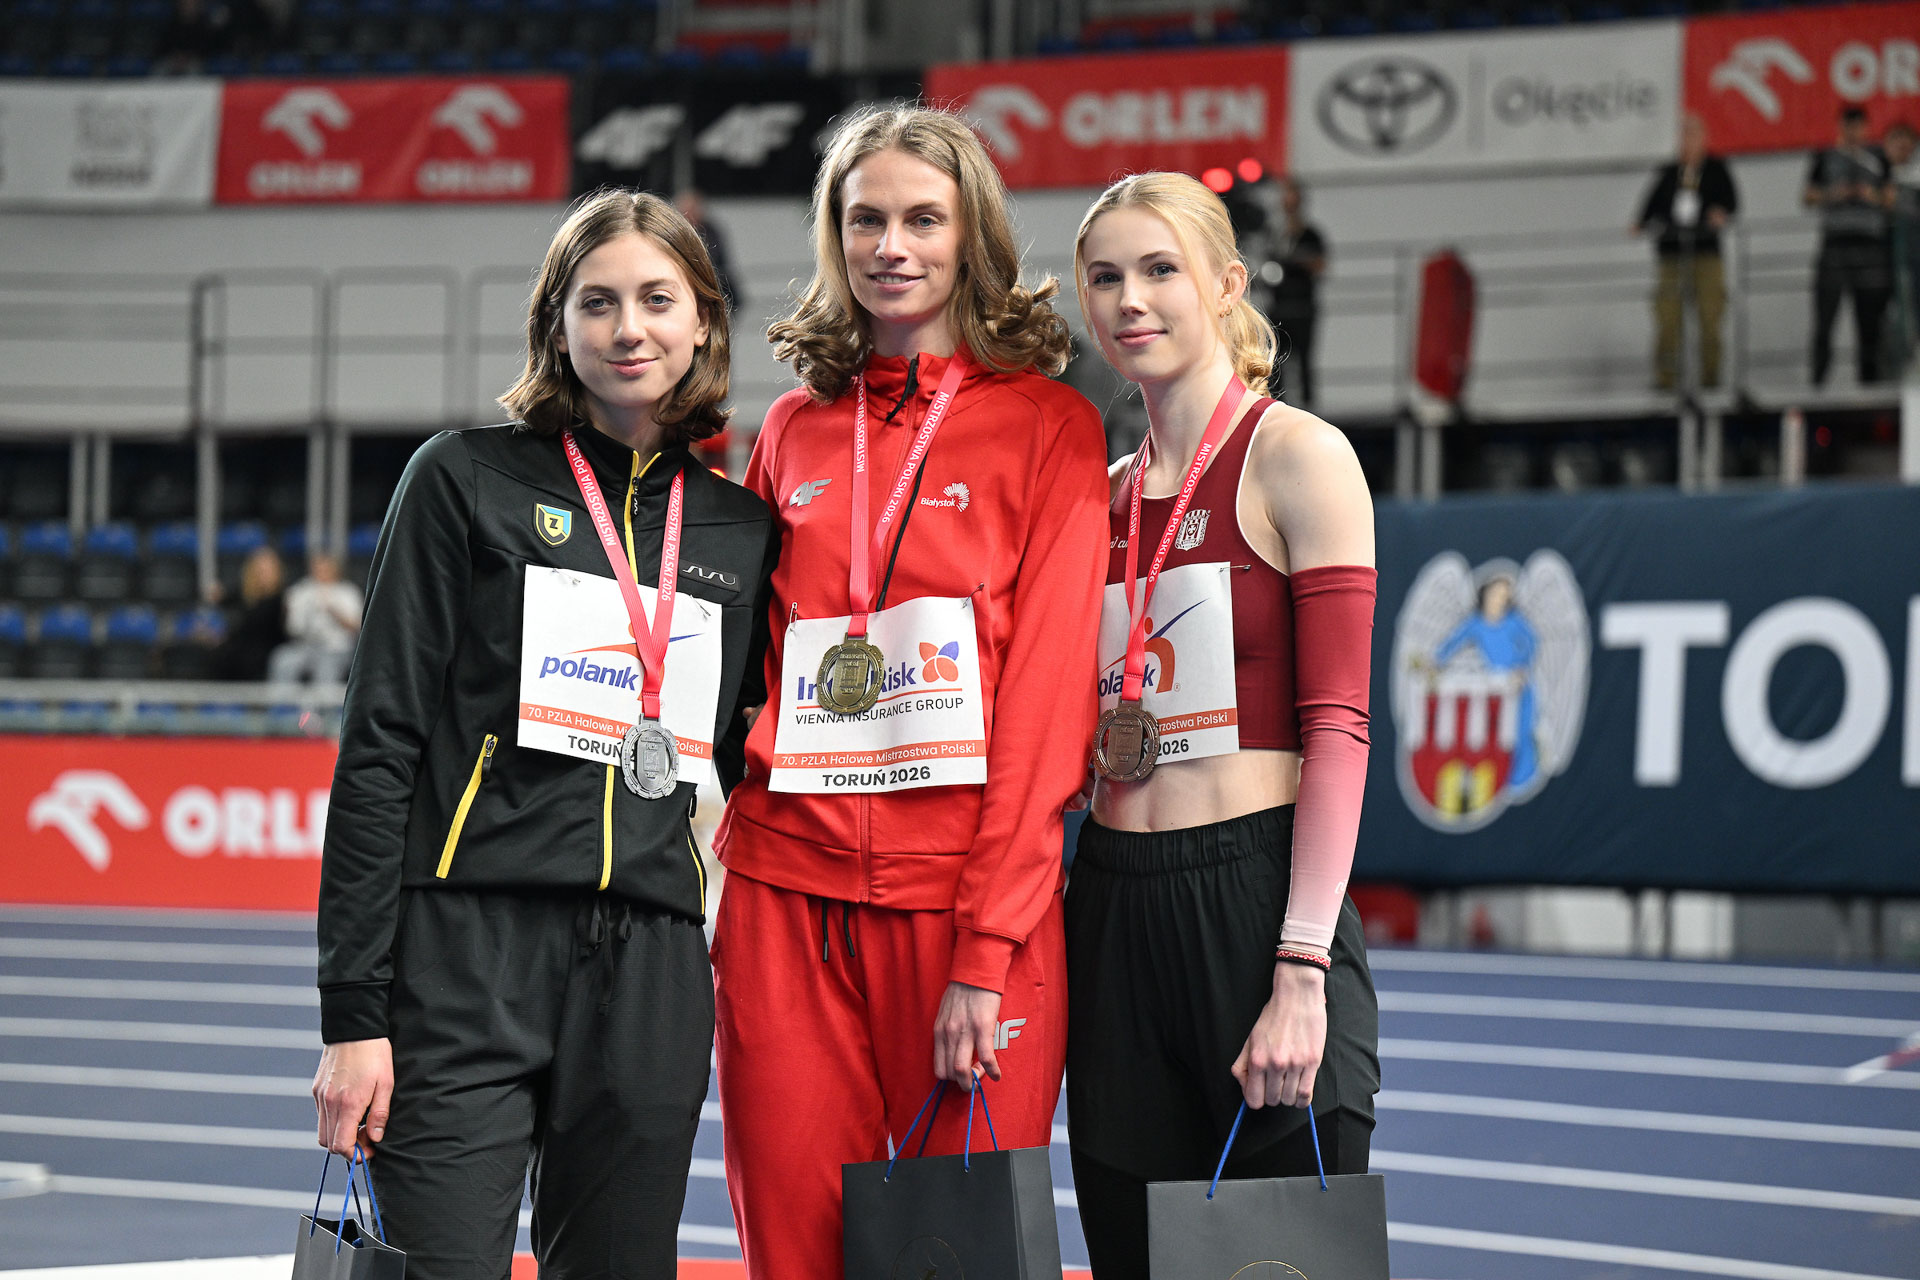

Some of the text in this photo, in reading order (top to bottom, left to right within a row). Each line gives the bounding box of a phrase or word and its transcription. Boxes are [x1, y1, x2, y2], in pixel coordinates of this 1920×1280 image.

[1829, 38, 1920, 101] OR
[1061, 86, 1267, 148] ORLEN
[881, 391, 950, 523] MISTRZOSTWA POLSKI 2026
[566, 437, 617, 547] MISTRZOSTWA POLSKI
[789, 478, 833, 507] 4F
[1174, 443, 1212, 516] MISTRZOSTWA
[921, 497, 955, 508] Białystok
[661, 475, 682, 602] MISTRZOSTWA POLSKI 2026
[1158, 518, 1180, 555] POLSKI
[1148, 556, 1163, 583] 2026
[1099, 663, 1156, 697] olak
[528, 706, 545, 719] 70.
[547, 710, 572, 724] PZLA
[575, 715, 614, 733] Halowe
[795, 697, 964, 725] VIENNA INSURANCE GROUP
[1158, 711, 1228, 732] rzostwa Polski
[781, 743, 976, 766] 70. PZLA Halowe Mistrzostwa Polski
[822, 765, 932, 787] TORUŃ 2026
[162, 784, 332, 860] ORL
[993, 1017, 1027, 1050] F
